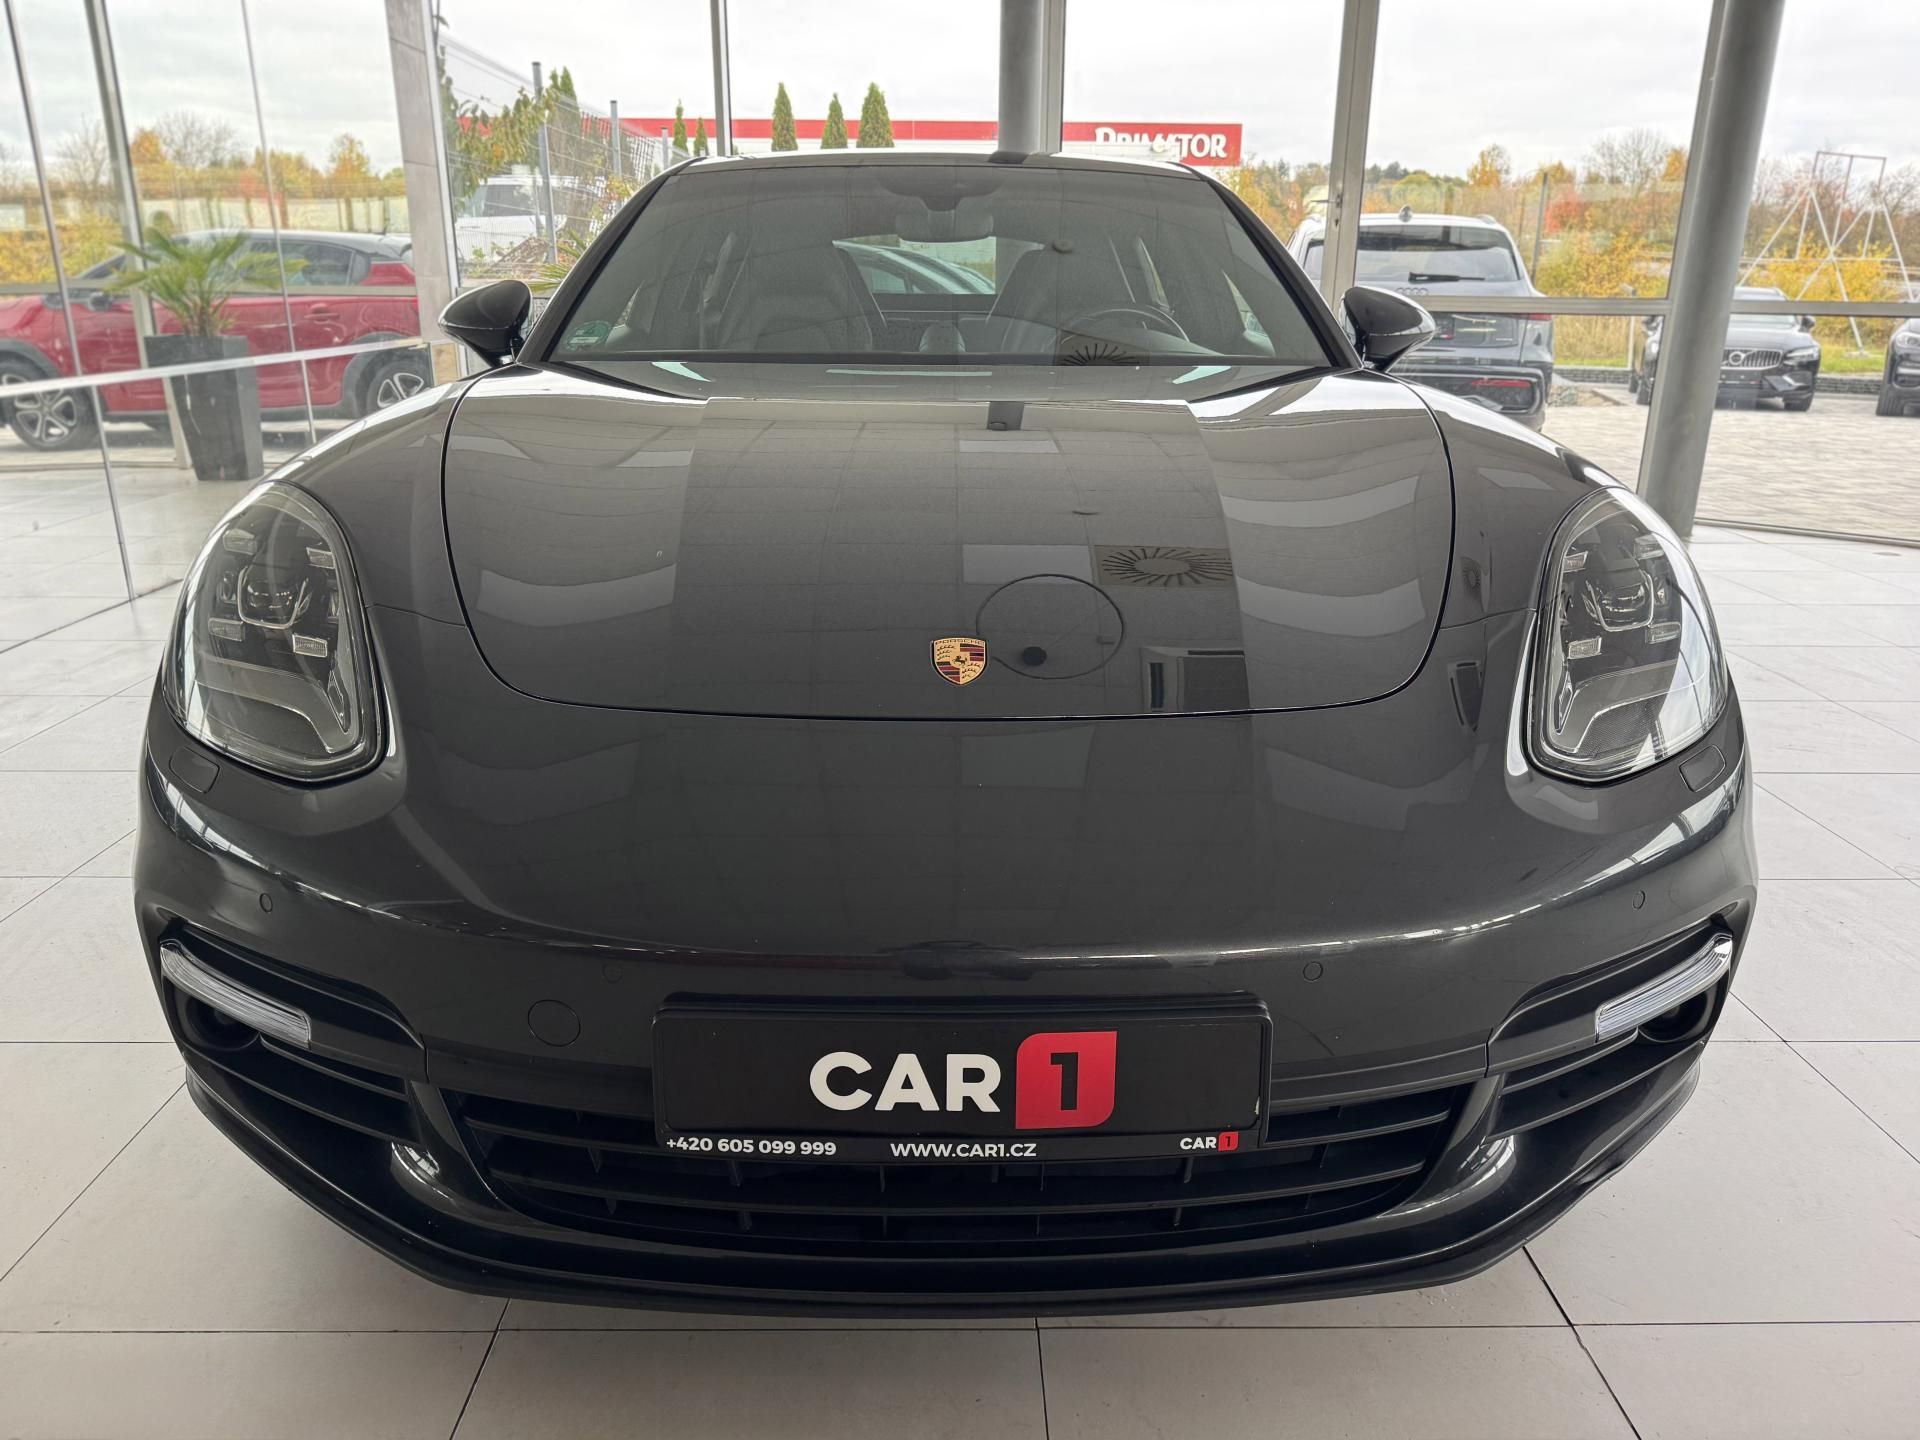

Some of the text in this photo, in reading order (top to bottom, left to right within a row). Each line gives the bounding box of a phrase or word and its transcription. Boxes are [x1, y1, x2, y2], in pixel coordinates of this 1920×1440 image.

[809, 1051, 1001, 1113] CAR
[666, 1136, 837, 1156] +420 605 099 999
[890, 1143, 1037, 1158] WWW.CAR1.CZ
